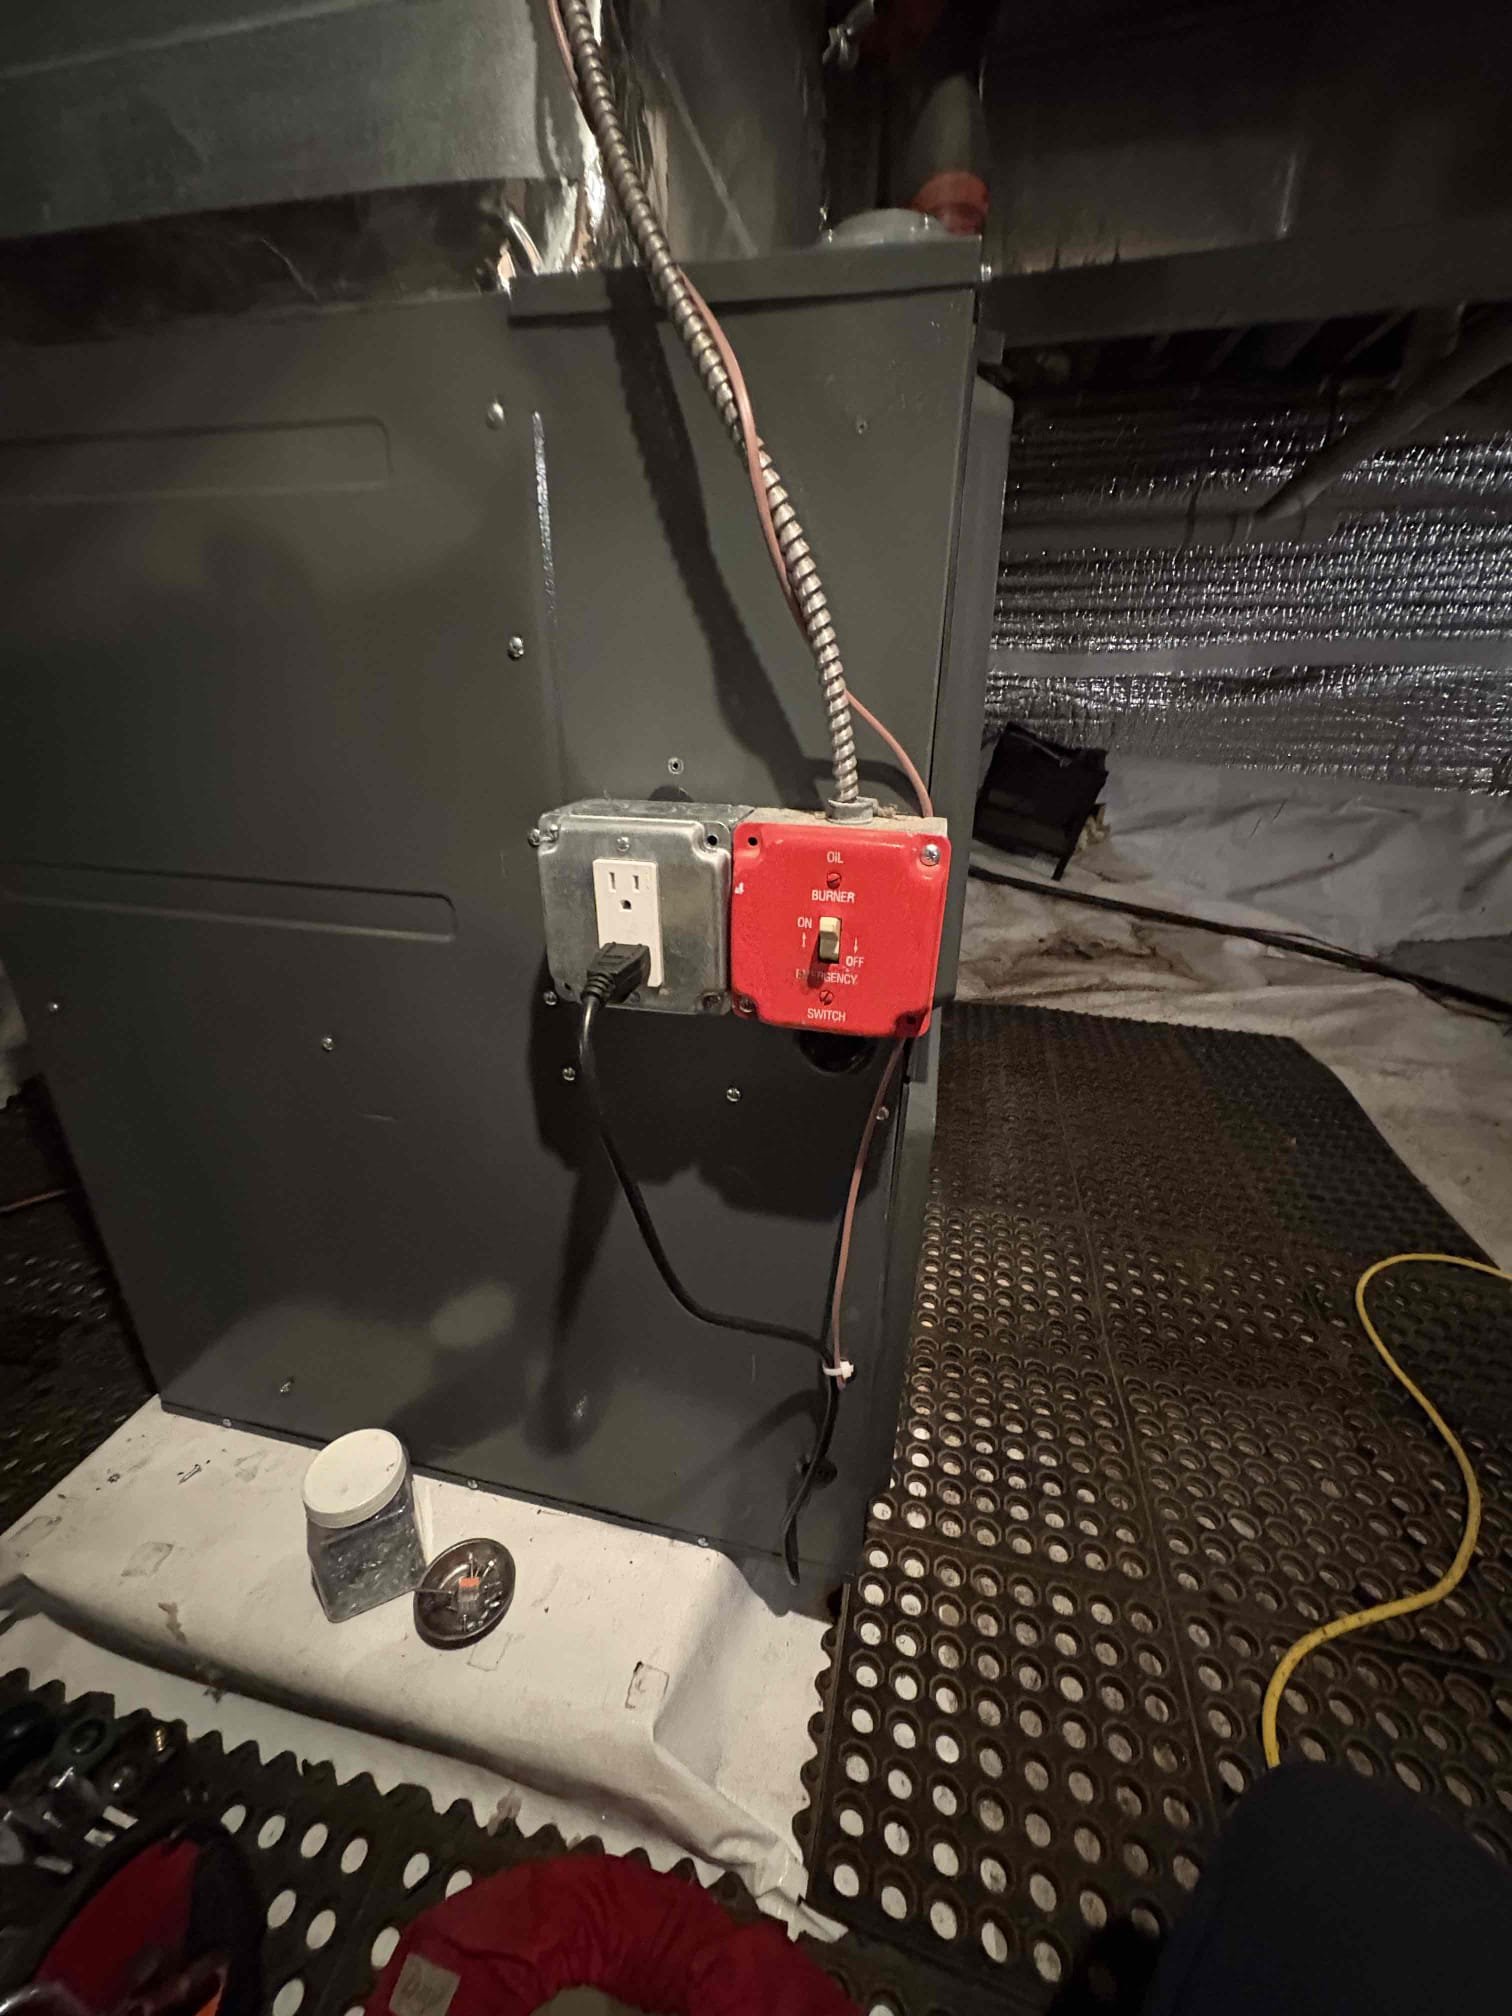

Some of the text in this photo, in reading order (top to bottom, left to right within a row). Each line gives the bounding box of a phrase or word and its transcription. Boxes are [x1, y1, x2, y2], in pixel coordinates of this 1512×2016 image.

[827, 852, 843, 864] OIL
[812, 890, 855, 903] BURNER
[797, 918, 812, 928] ON
[846, 956, 864, 967] OFF
[796, 969, 858, 985] ERGENCY
[808, 1008, 846, 1022] SWITCH
